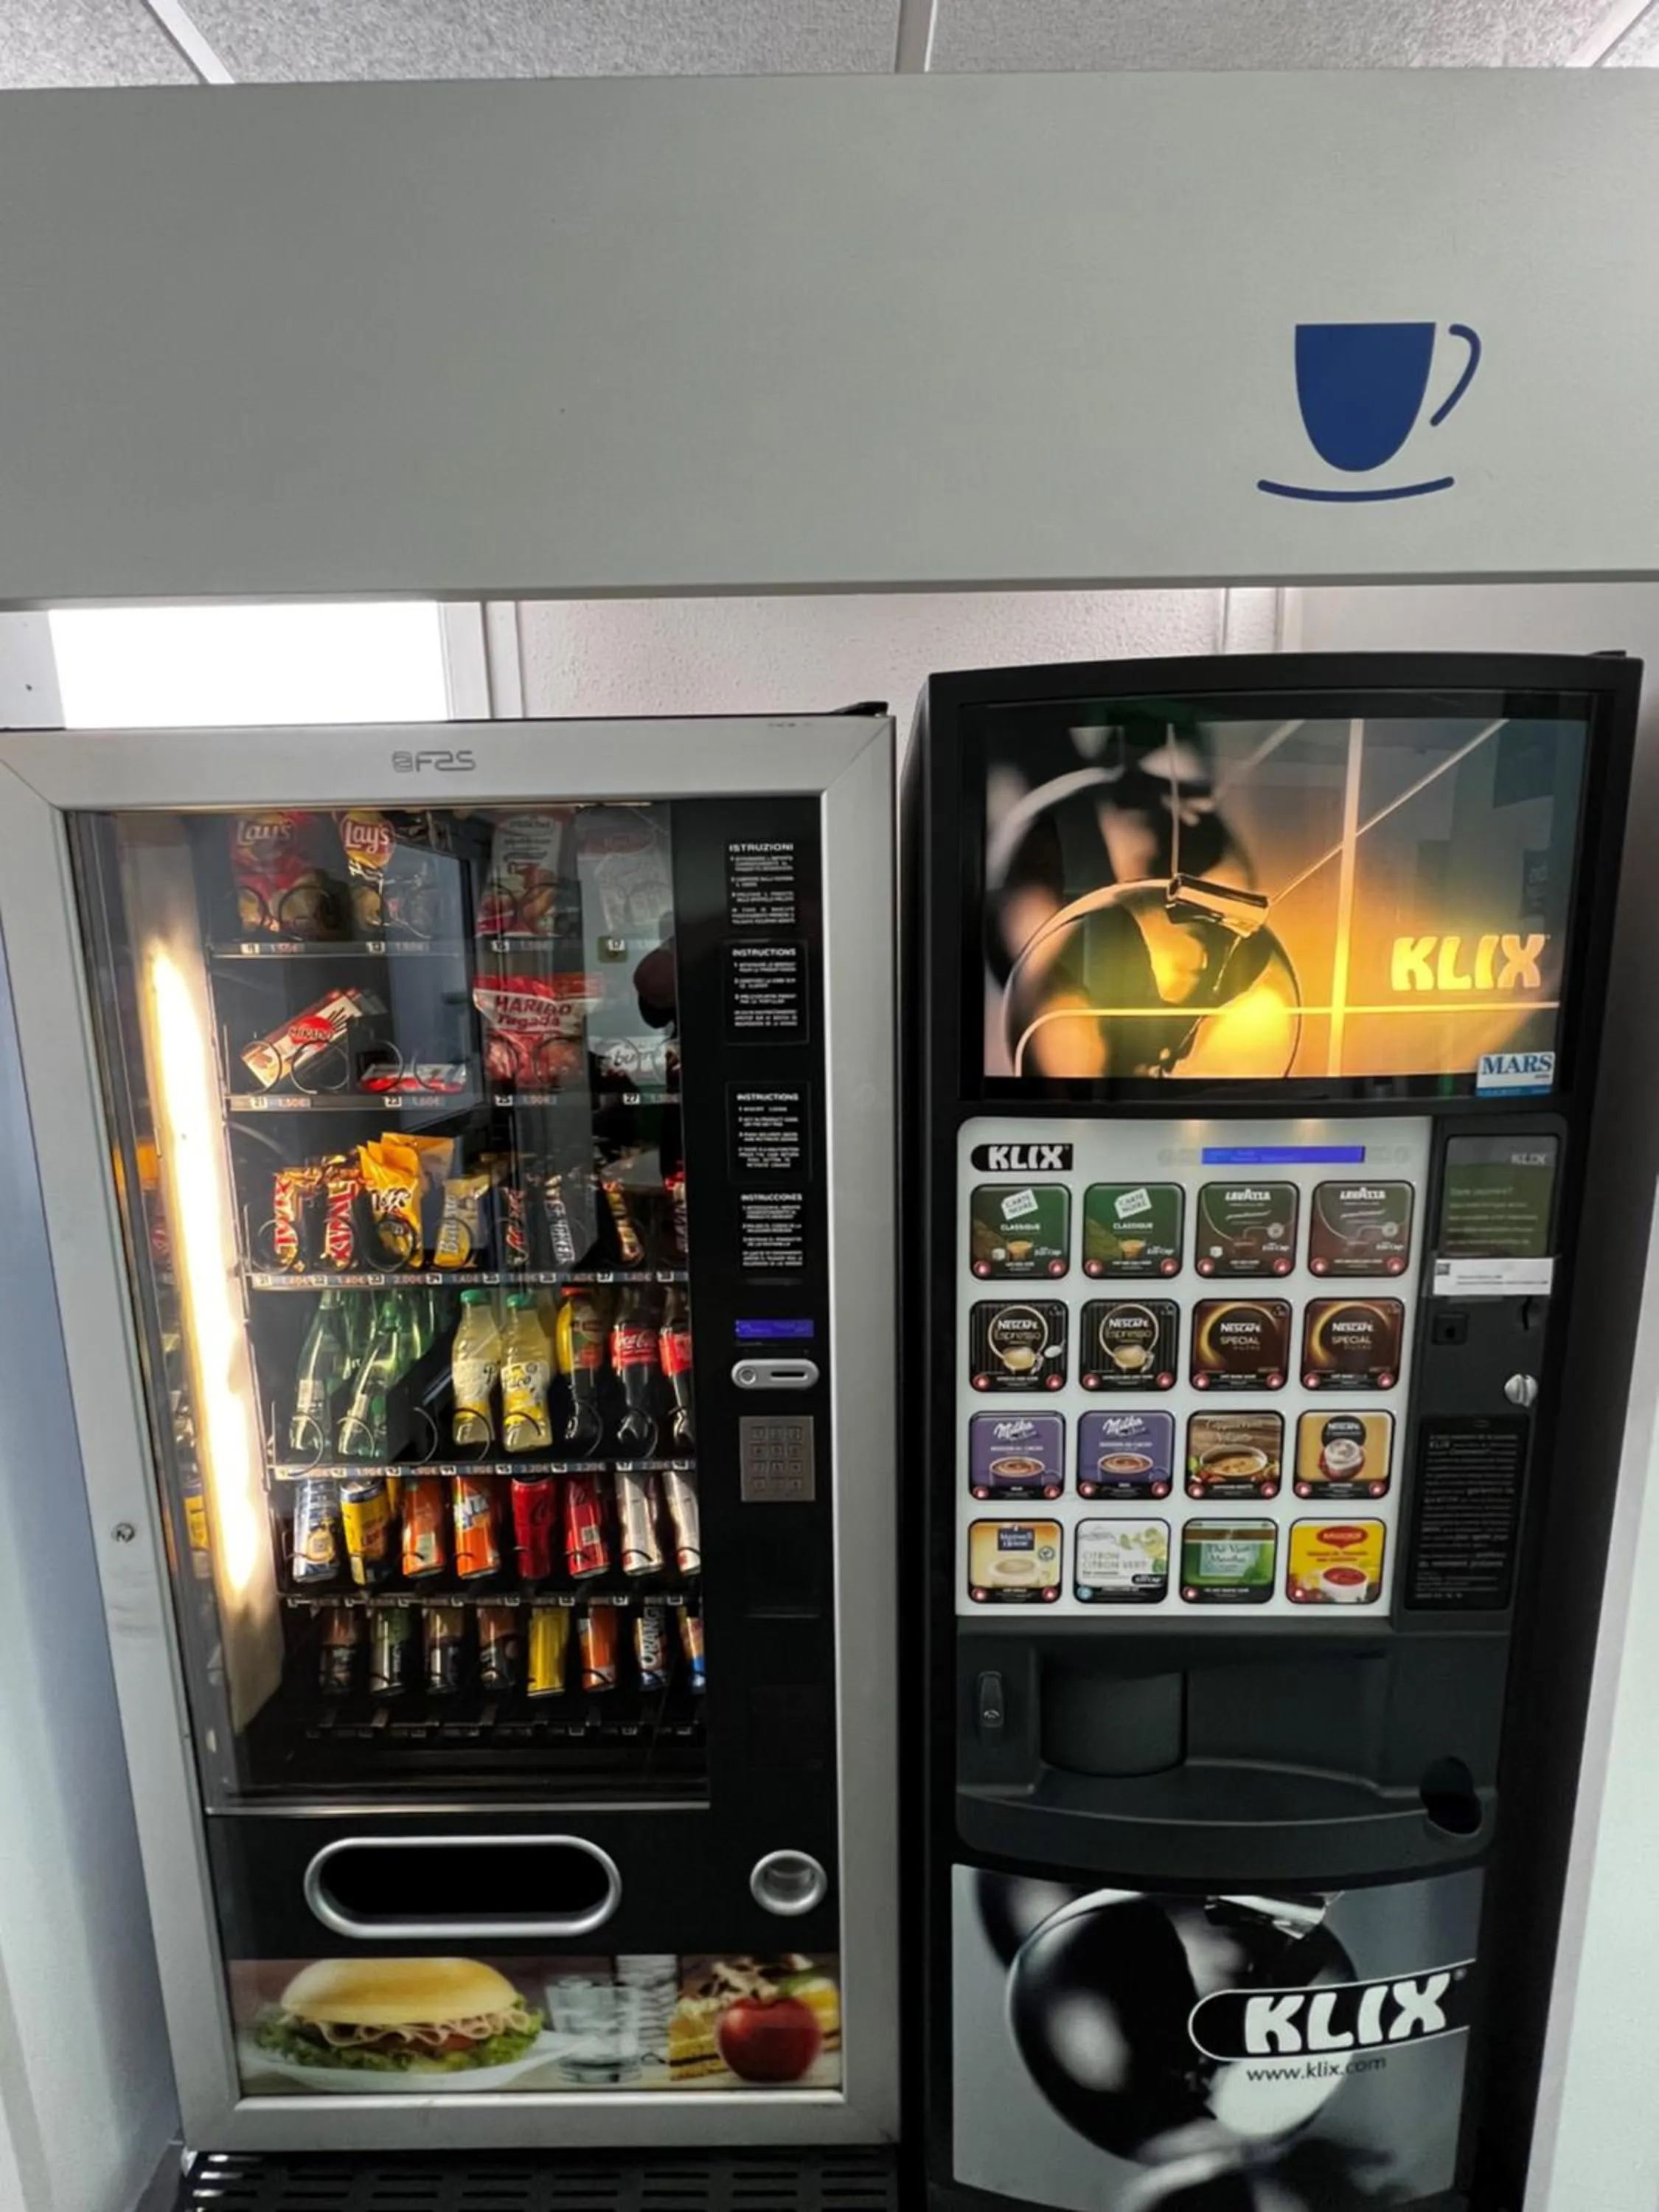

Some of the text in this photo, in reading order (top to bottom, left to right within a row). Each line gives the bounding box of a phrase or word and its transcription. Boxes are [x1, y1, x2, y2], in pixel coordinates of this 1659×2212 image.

[345, 818, 391, 853] Lay's
[728, 843, 795, 853] ISTRUZIONI
[731, 947, 797, 957] INSTRUCTIONS
[1391, 933, 1546, 991] KLIX
[495, 995, 573, 1016] HARIBO
[1481, 1054, 1553, 1076] MARS
[737, 1093, 799, 1102] INSTRUCTIONS
[988, 1145, 1063, 1170] KLIX
[993, 1417, 1034, 1439] Milka
[1102, 1415, 1144, 1435] Milka
[1244, 1972, 1452, 2055] KLIX
[1247, 2057, 1387, 2081] www.klix.com
